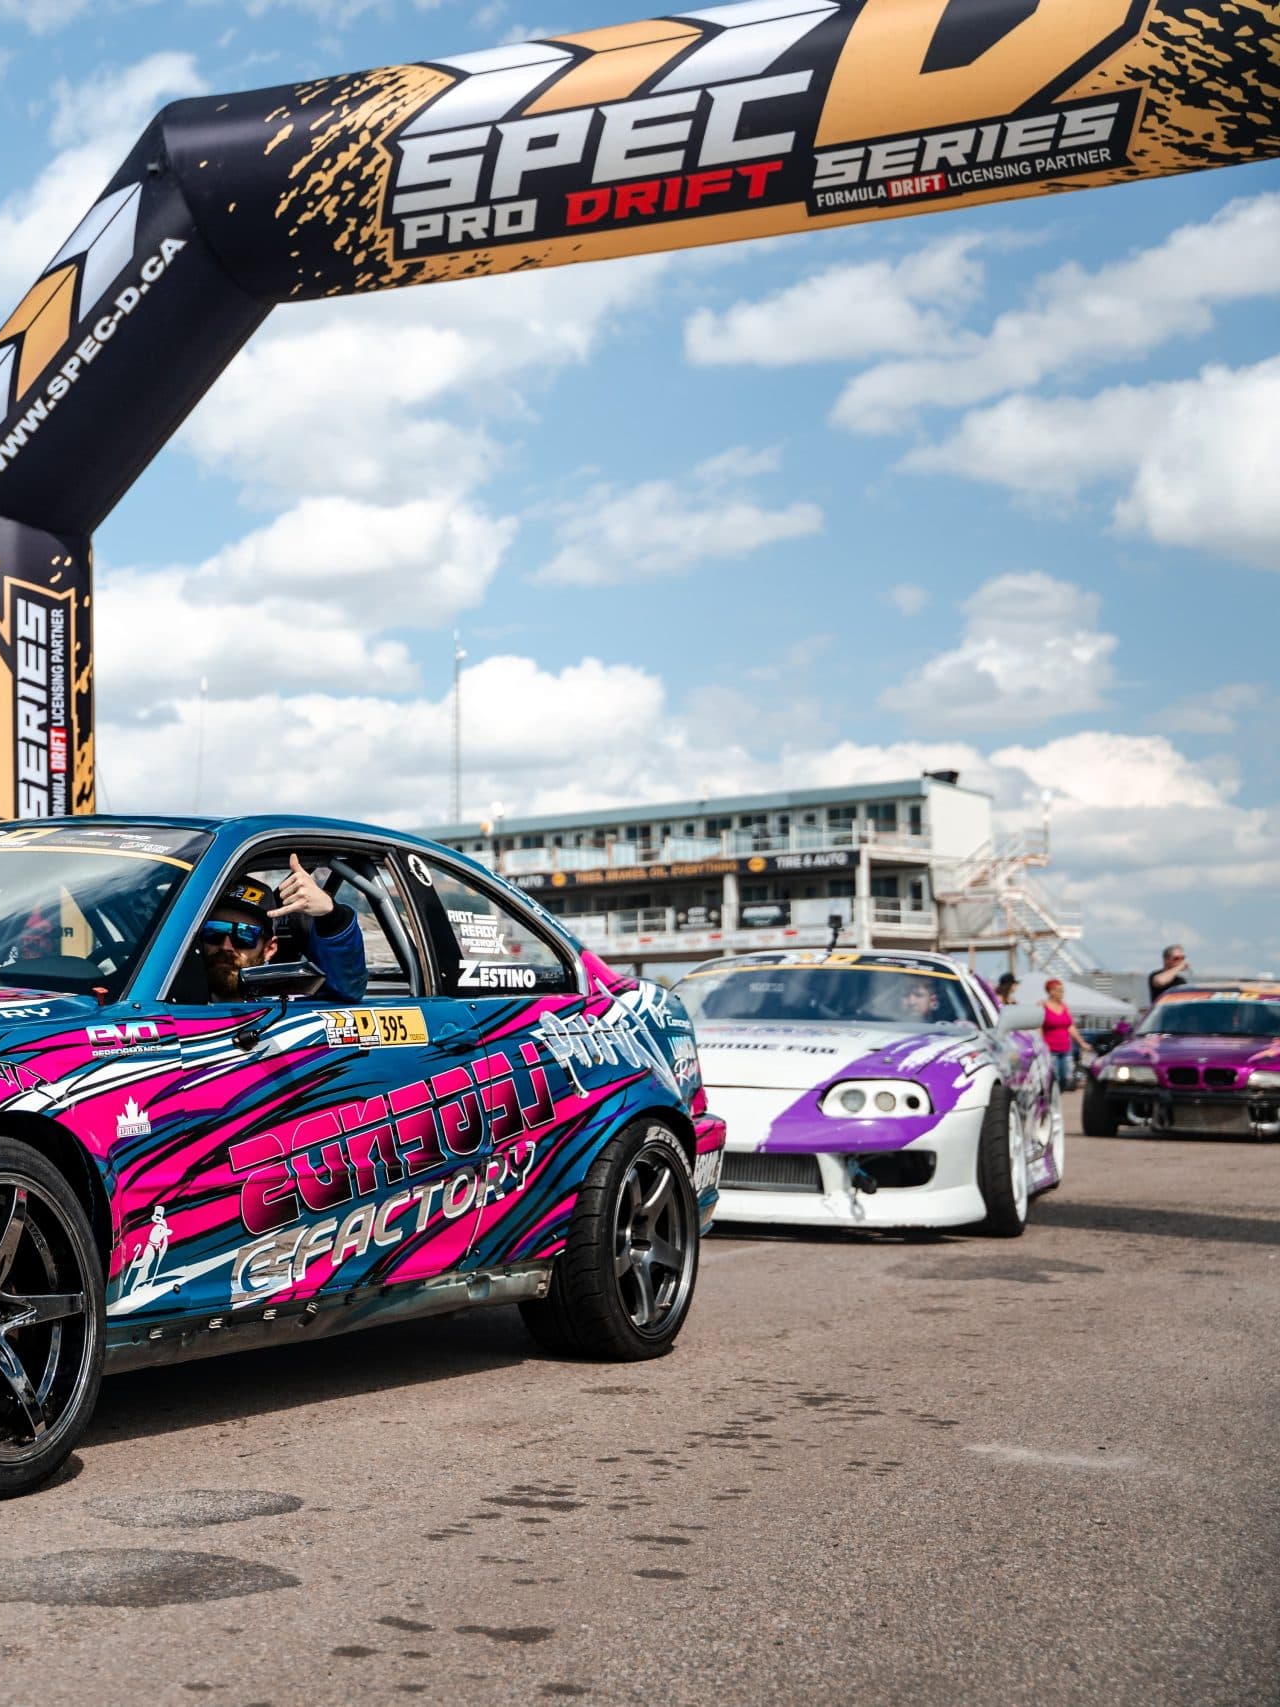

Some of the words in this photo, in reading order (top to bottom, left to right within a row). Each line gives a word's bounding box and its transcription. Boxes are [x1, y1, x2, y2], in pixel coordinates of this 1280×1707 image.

[392, 69, 814, 215] SPEC
[813, 103, 1120, 189] SERIES
[816, 183, 888, 208] FORMULA
[890, 172, 943, 199] DRIFT
[948, 157, 1032, 188] LICENSING
[1035, 147, 1112, 173] PARTNER
[401, 199, 538, 251] PRO
[564, 160, 784, 227] DRIFT
[50, 608, 65, 662] PARTNER
[16, 598, 49, 820] SERIES
[51, 663, 65, 727] LICENSING
[50, 728, 67, 771] DRIFT
[776, 856, 802, 869] TIRE
[814, 852, 848, 866] AUTO
[447, 909, 474, 924] RIOT
[457, 959, 537, 989] ZESTINO
[86, 1021, 162, 1048] EVO
[327, 1026, 359, 1039] SPEC
[379, 1015, 408, 1042] 395
